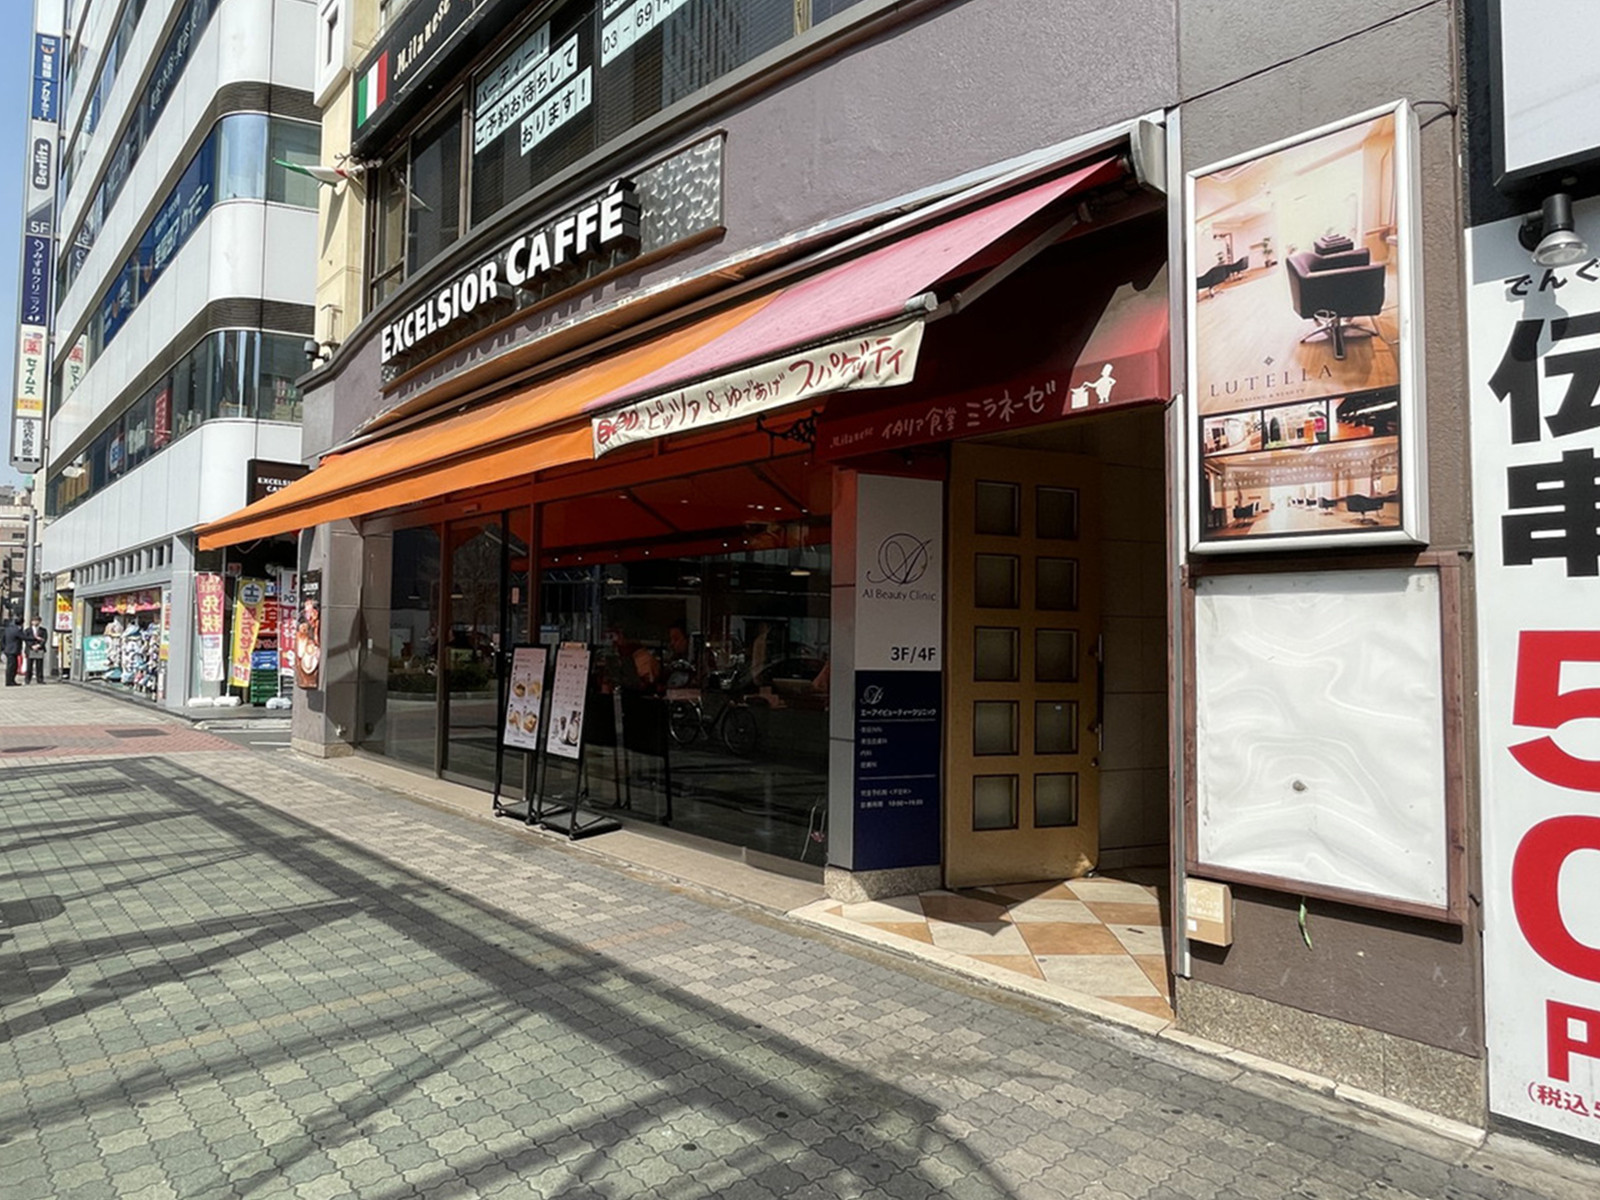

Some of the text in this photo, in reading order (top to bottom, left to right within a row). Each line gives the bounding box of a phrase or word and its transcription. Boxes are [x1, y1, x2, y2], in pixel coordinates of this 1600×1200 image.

[476, 44, 576, 146] ご予約お待ちして
[521, 78, 586, 148] おります！
[35, 143, 49, 186] Berlitz
[30, 221, 50, 233] 5F
[381, 179, 623, 364] EXCELSIOR CAFFÉ
[24, 357, 37, 396] セイムス
[1210, 364, 1333, 398] LUTELLA
[966, 380, 1056, 428] ミラネーゼ
[876, 589, 907, 601] Beauty
[909, 589, 937, 601] Clinic
[890, 646, 937, 664] 3F/4F
